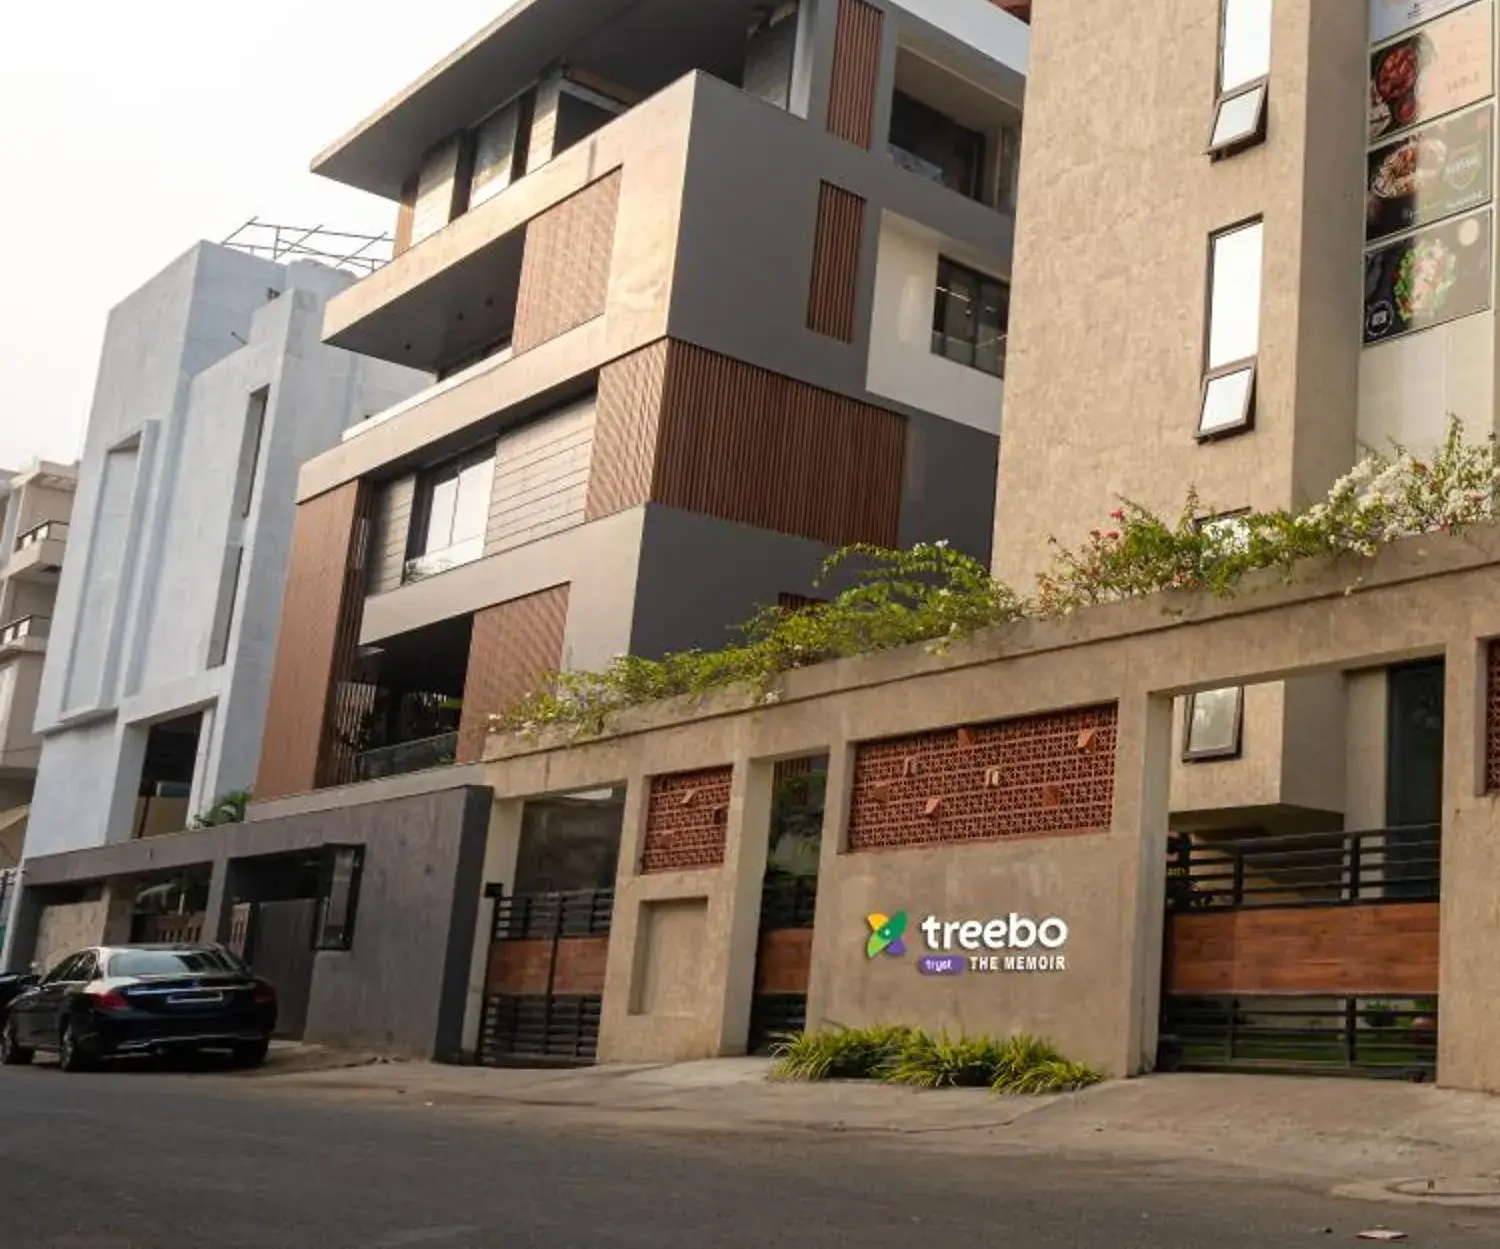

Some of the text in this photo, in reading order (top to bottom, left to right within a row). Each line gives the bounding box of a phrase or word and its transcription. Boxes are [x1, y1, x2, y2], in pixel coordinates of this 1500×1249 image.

[921, 912, 1068, 950] treebo
[969, 956, 998, 970] THE
[1004, 956, 1066, 970] MEMOIR
